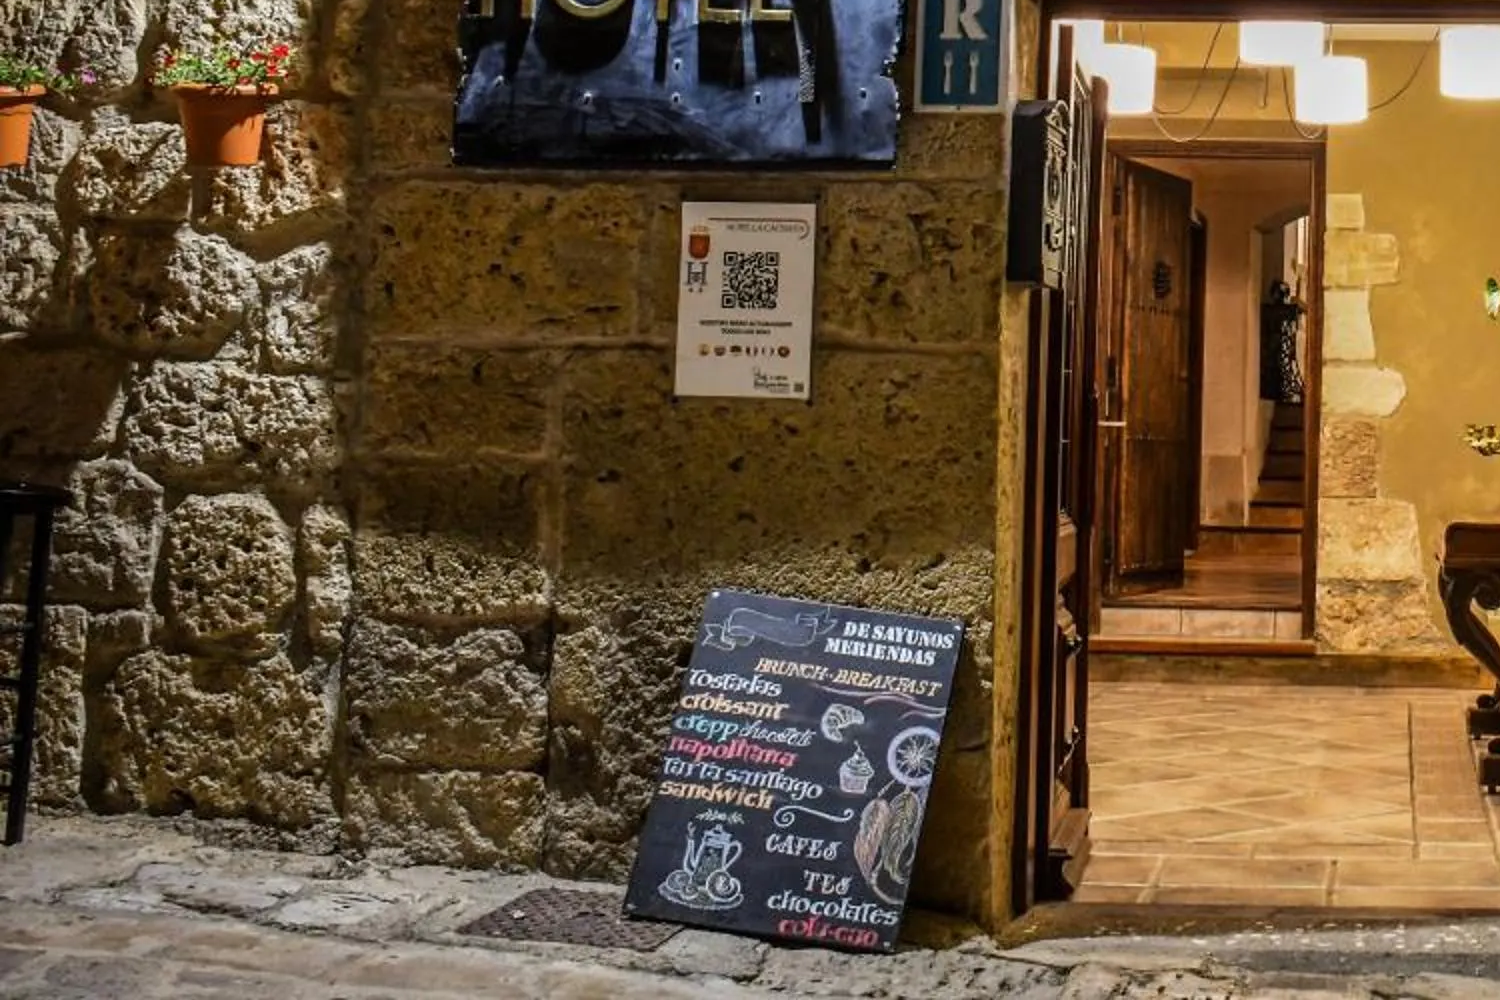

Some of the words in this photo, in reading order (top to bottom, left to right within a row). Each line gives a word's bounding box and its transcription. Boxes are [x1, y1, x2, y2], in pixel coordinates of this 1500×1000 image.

[824, 638, 936, 667] MERIENDAS
[680, 692, 790, 720] croissant
[659, 781, 775, 810] sandwich
[725, 768, 823, 801] santiago
[767, 889, 898, 926] chocolates
